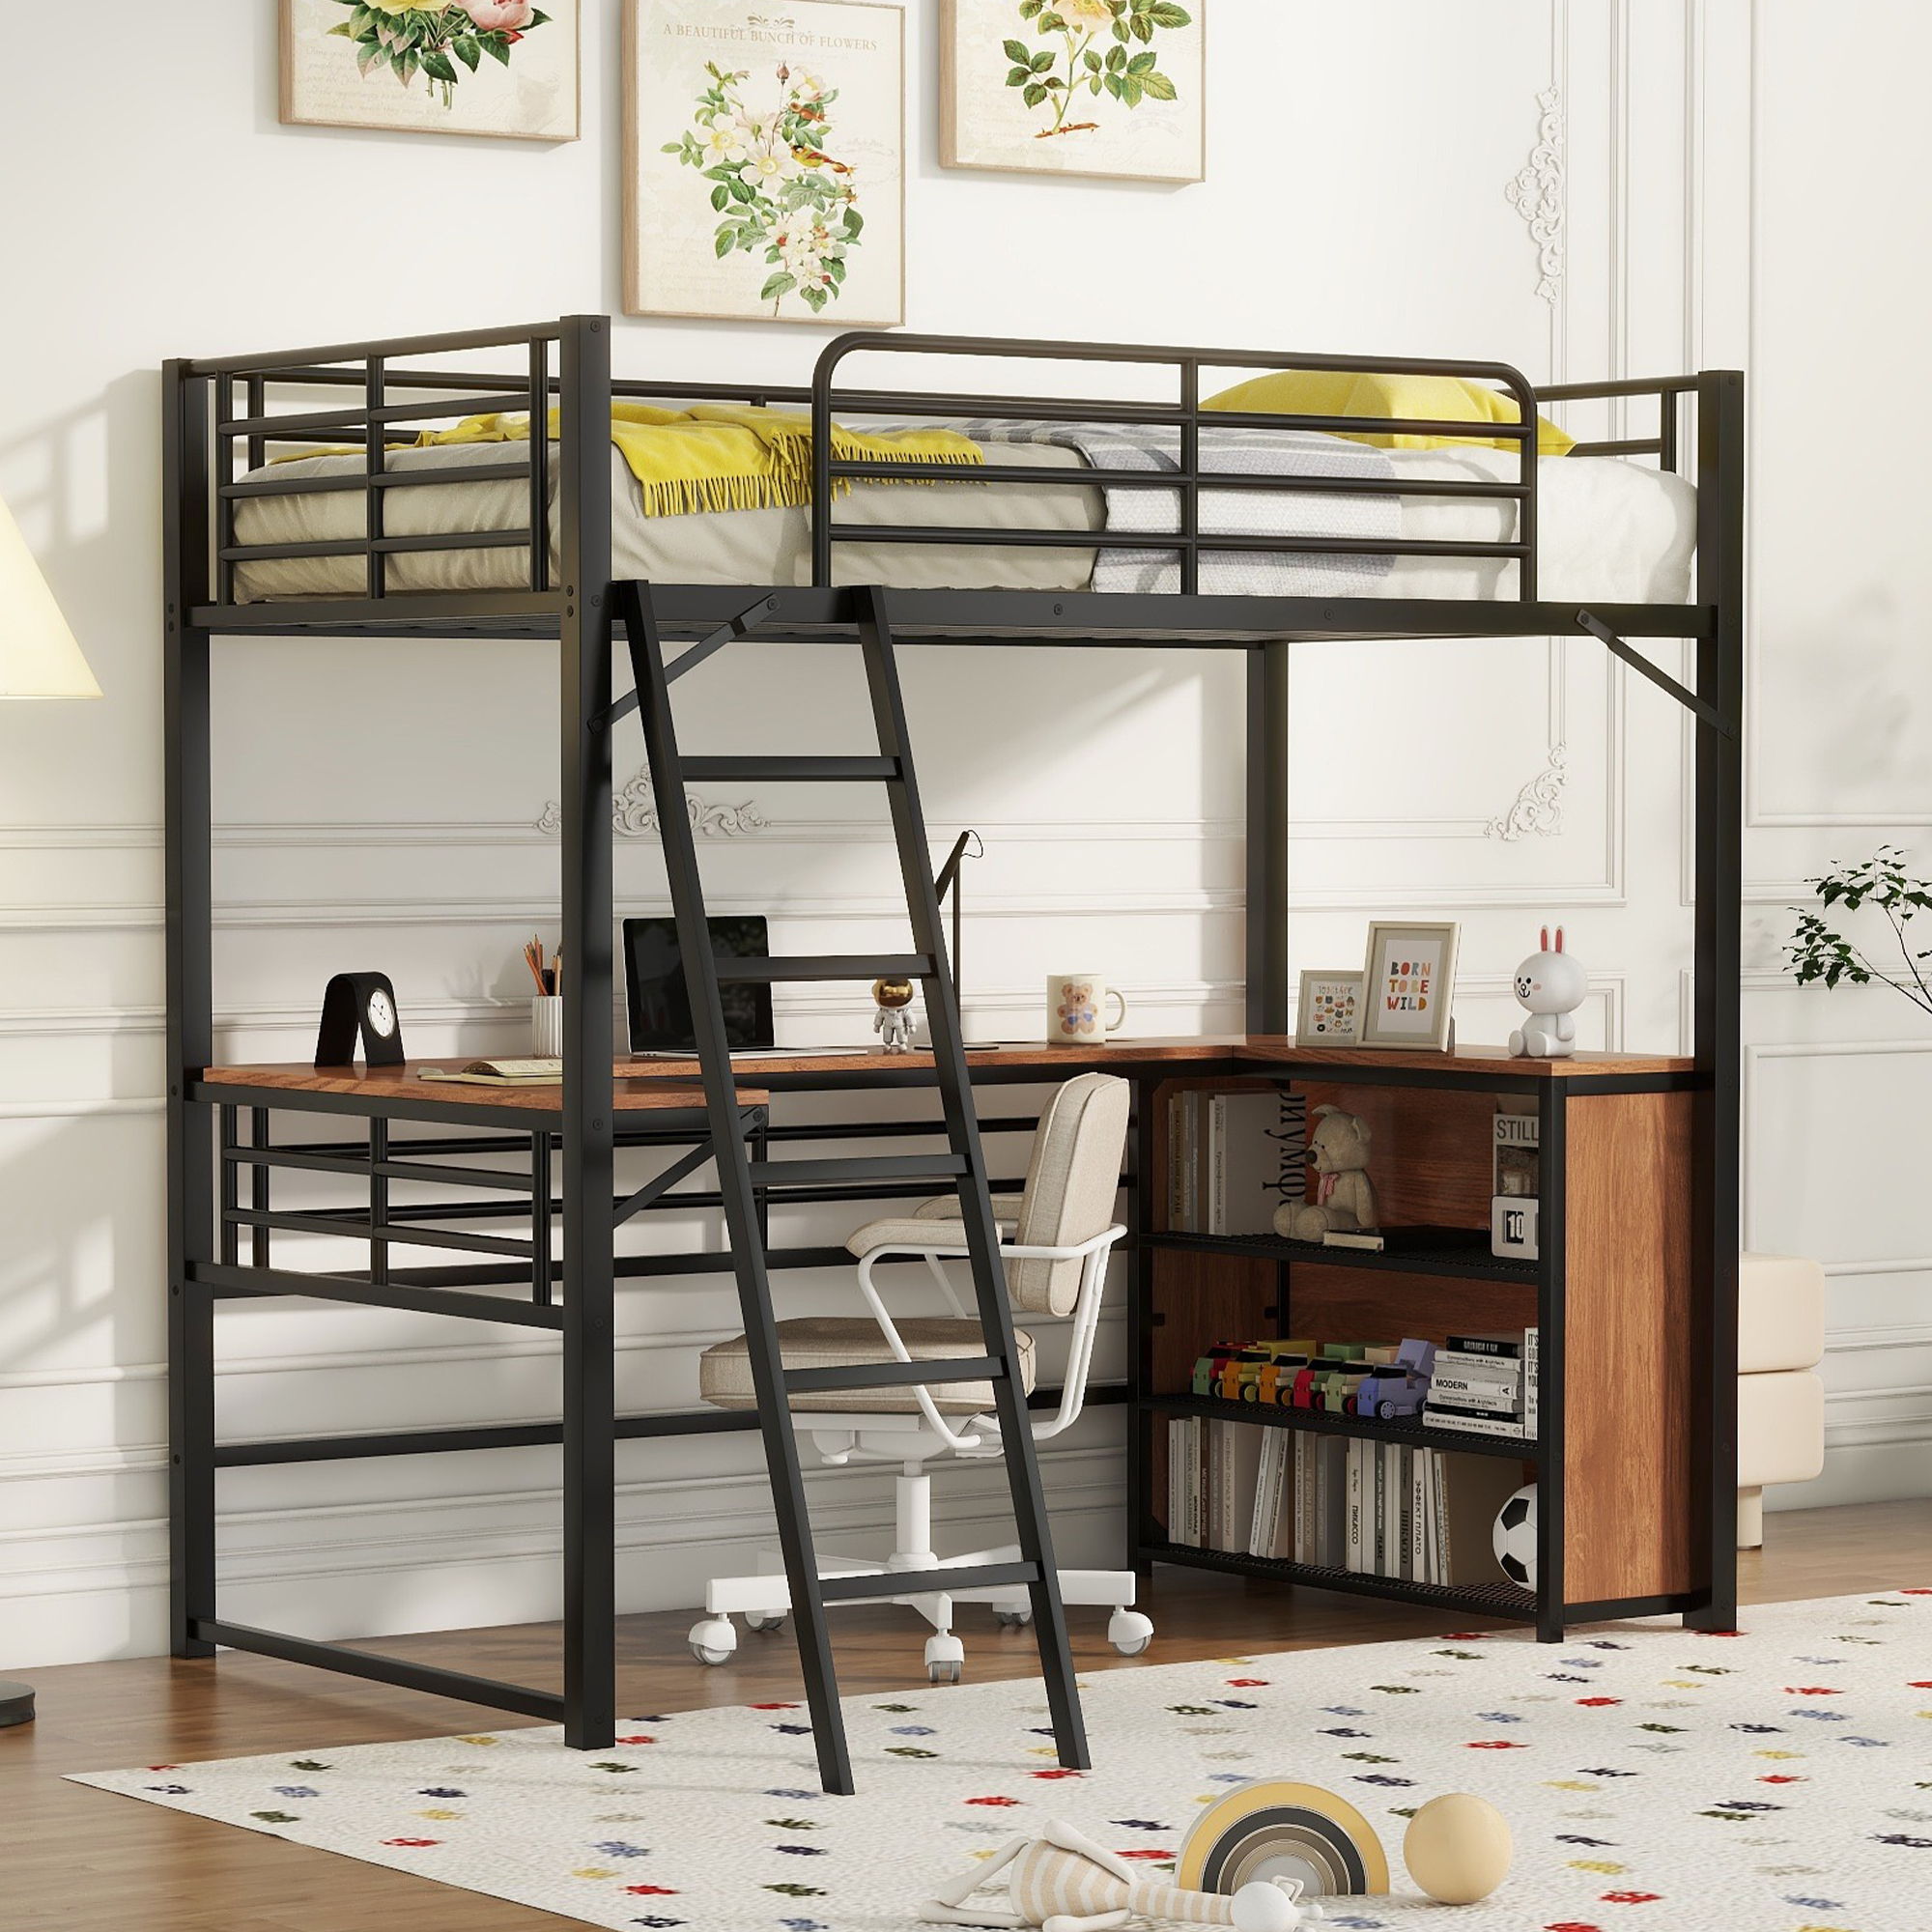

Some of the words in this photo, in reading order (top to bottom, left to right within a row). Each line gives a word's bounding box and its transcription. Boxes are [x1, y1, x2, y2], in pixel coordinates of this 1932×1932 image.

[664, 23, 671, 35] A
[676, 24, 745, 41] BEAUTIFUL
[751, 30, 794, 44] BUNCH
[799, 34, 815, 46] OF
[819, 36, 877, 51] FLOWERS
[1391, 961, 1431, 976] BORN
[1389, 979, 1407, 993] TO
[1410, 980, 1429, 994] BE
[1387, 996, 1427, 1010] WILD
[1508, 1213, 1524, 1238] 10
[1435, 1378, 1468, 1391] MODERN
